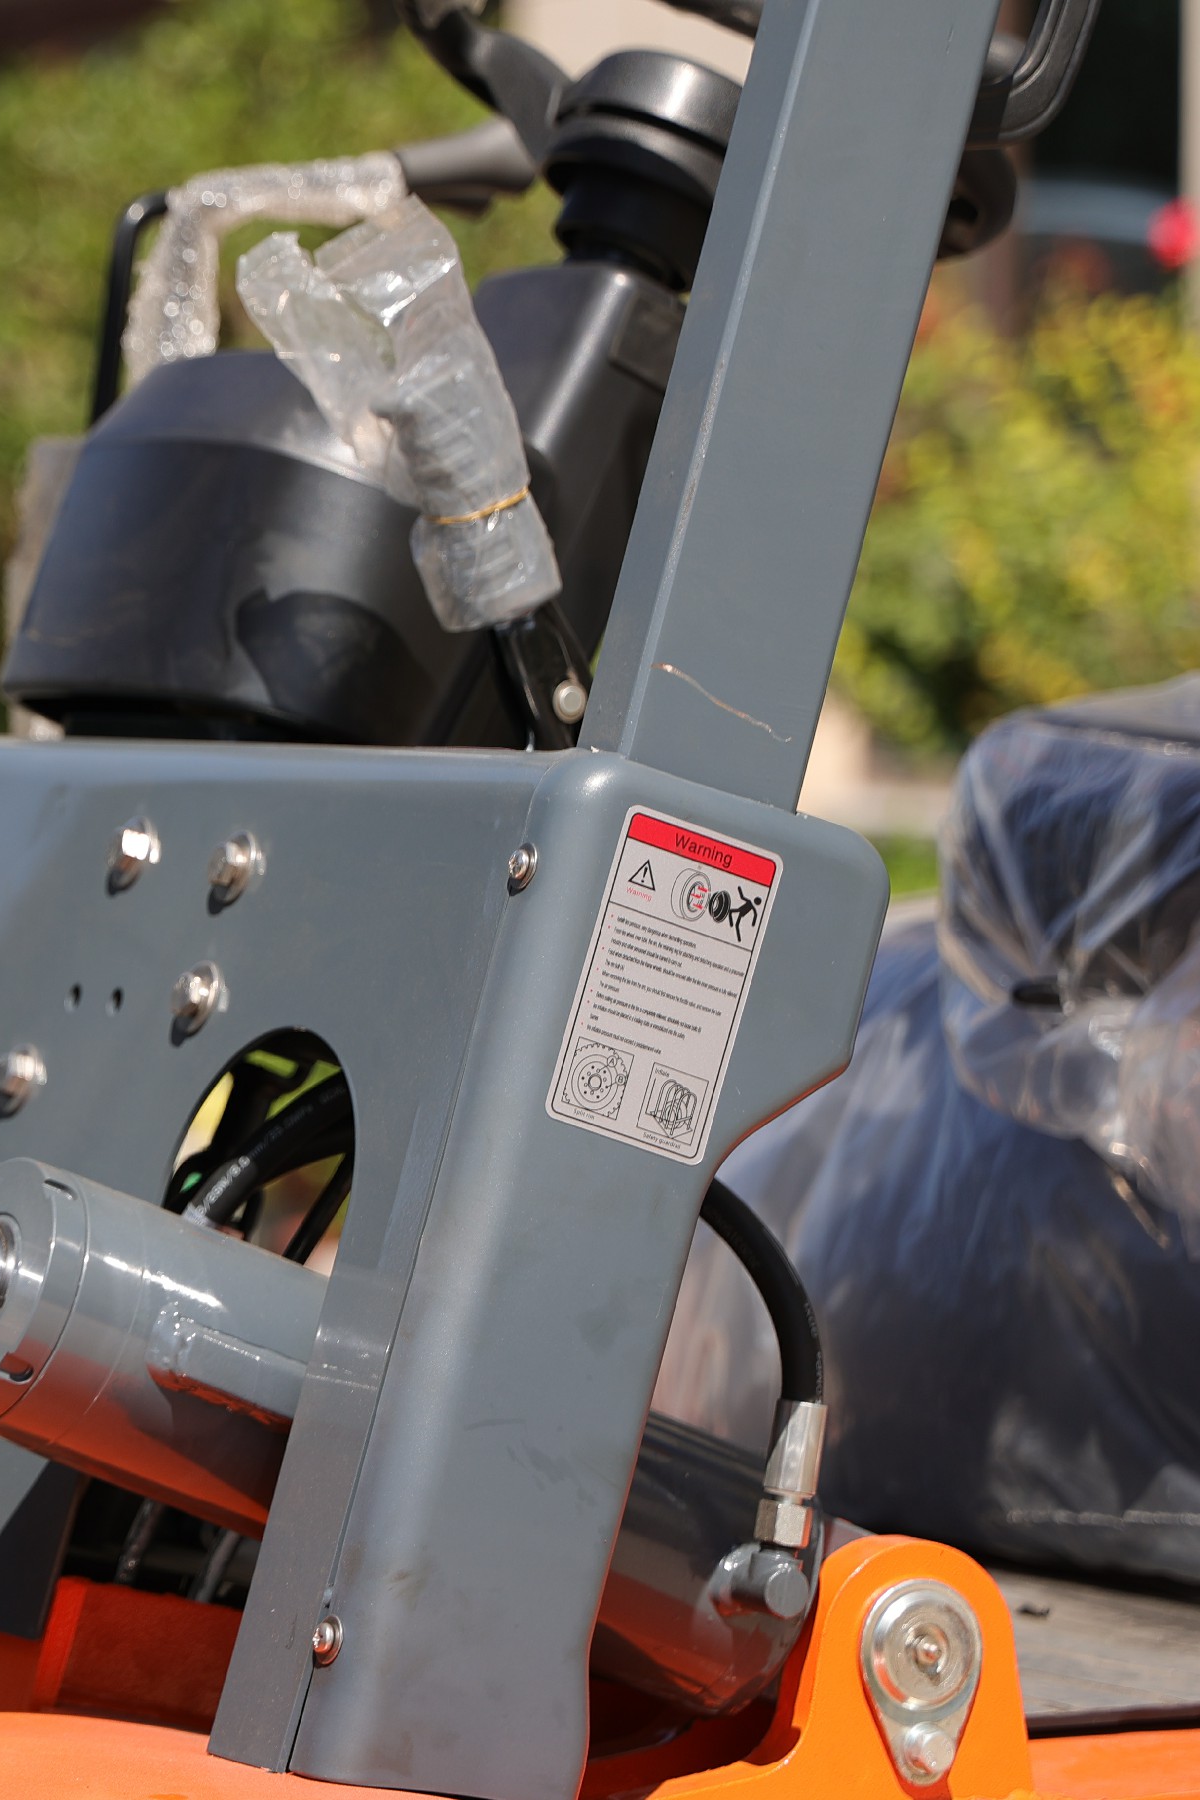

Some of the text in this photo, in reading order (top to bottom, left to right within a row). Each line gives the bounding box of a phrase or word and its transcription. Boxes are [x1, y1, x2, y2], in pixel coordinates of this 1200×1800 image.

[675, 832, 734, 869] Warning
[625, 886, 654, 902] Warning
[608, 1057, 616, 1066] A
[617, 1075, 625, 1084] B
[573, 1108, 586, 1117] Split
[642, 1132, 658, 1143] Safety
